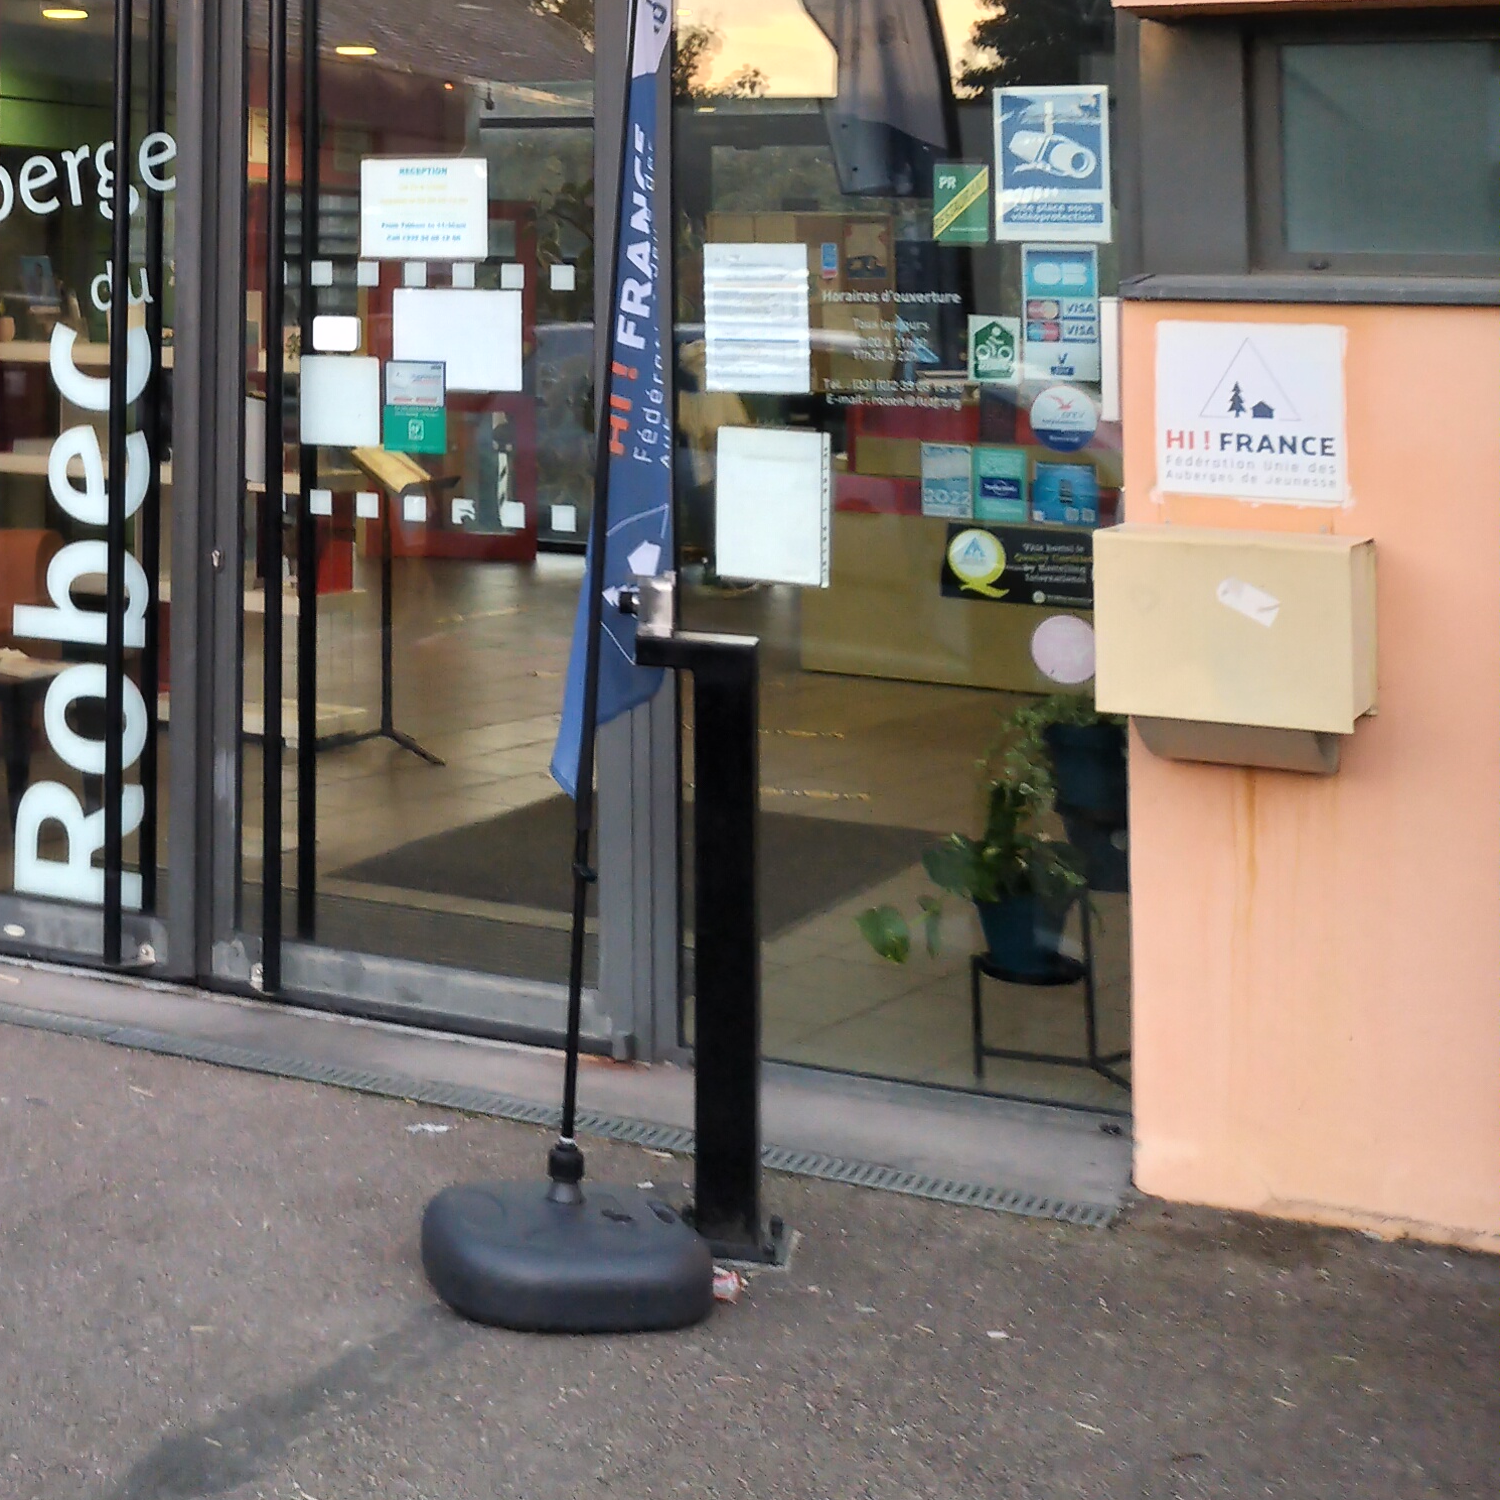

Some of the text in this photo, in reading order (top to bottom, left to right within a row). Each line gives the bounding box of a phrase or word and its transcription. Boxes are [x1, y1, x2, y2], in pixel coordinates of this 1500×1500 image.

[399, 166, 448, 176] RECEPTION
[91, 260, 154, 312] du
[822, 289, 962, 304] Horaires d'ouverture
[1067, 301, 1094, 314] VISA
[1066, 324, 1094, 338] VISA
[611, 360, 638, 381] !
[609, 393, 632, 457] HI
[1166, 429, 1336, 457] HI ! FRANCE
[1165, 455, 1255, 469] Fédération
[1308, 462, 1337, 475] des
[1166, 470, 1337, 489] Auberges de Jeunesse
[12, 321, 152, 909] Robec
